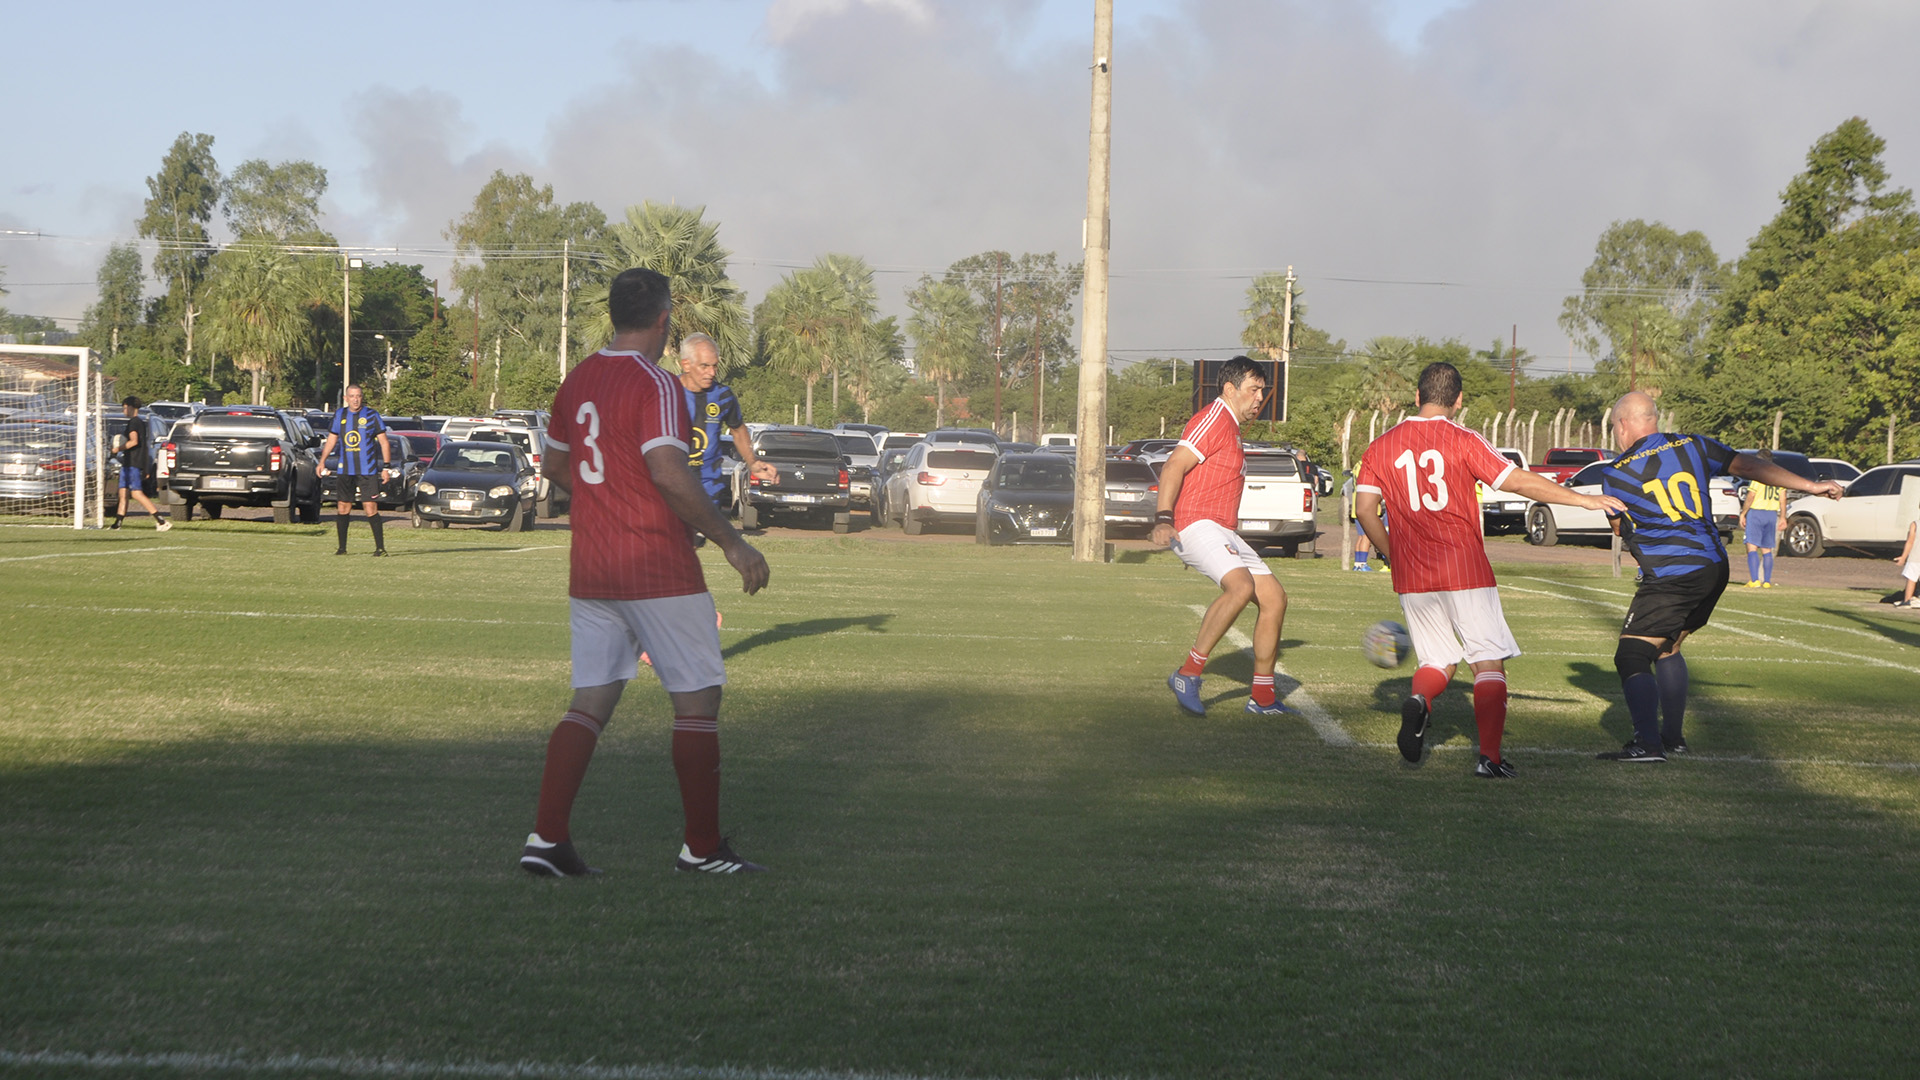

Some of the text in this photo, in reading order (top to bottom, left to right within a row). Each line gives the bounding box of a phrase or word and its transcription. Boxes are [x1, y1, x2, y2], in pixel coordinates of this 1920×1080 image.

[576, 401, 605, 485] 3
[1394, 449, 1449, 512] 13
[1642, 471, 1703, 523] 10
